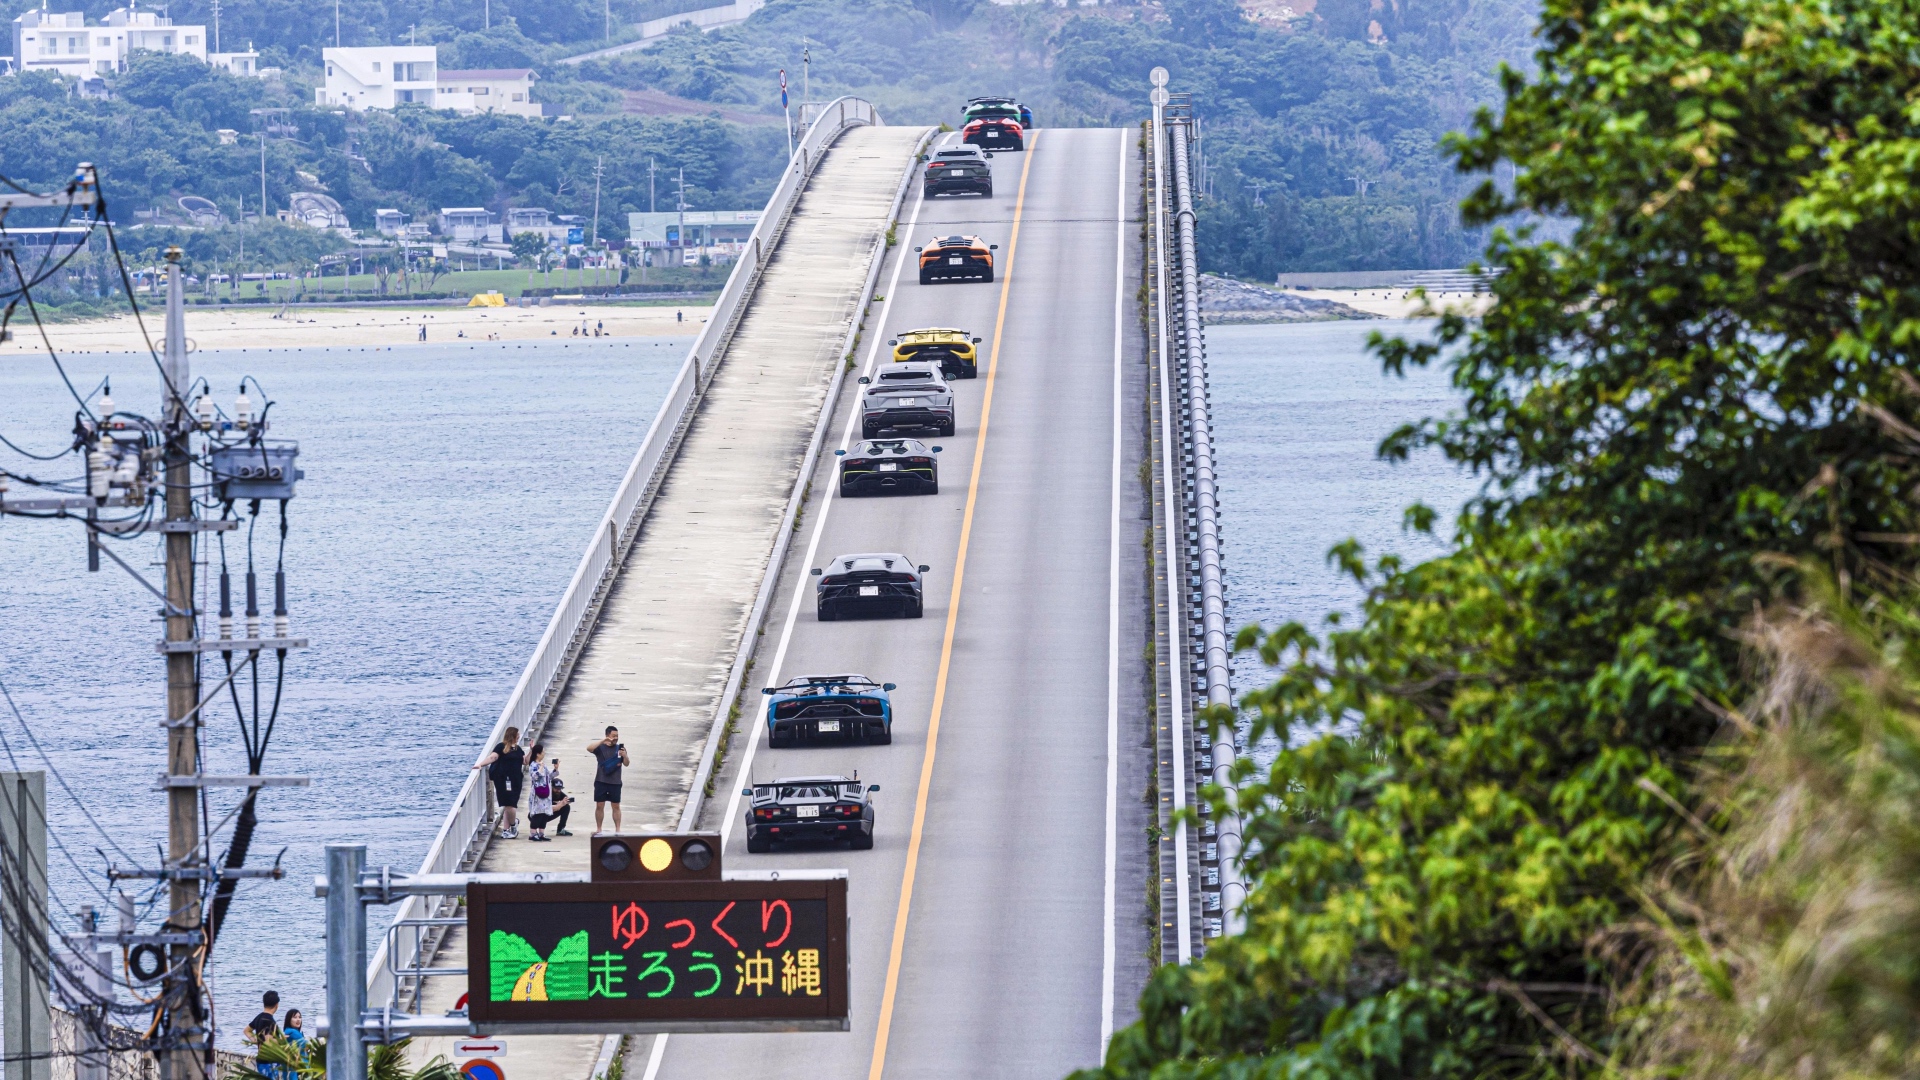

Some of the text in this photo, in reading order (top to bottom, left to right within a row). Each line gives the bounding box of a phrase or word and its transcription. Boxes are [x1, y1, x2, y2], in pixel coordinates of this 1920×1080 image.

[612, 900, 792, 950] ゆっくり
[589, 948, 822, 998] 走ろう沖縄
